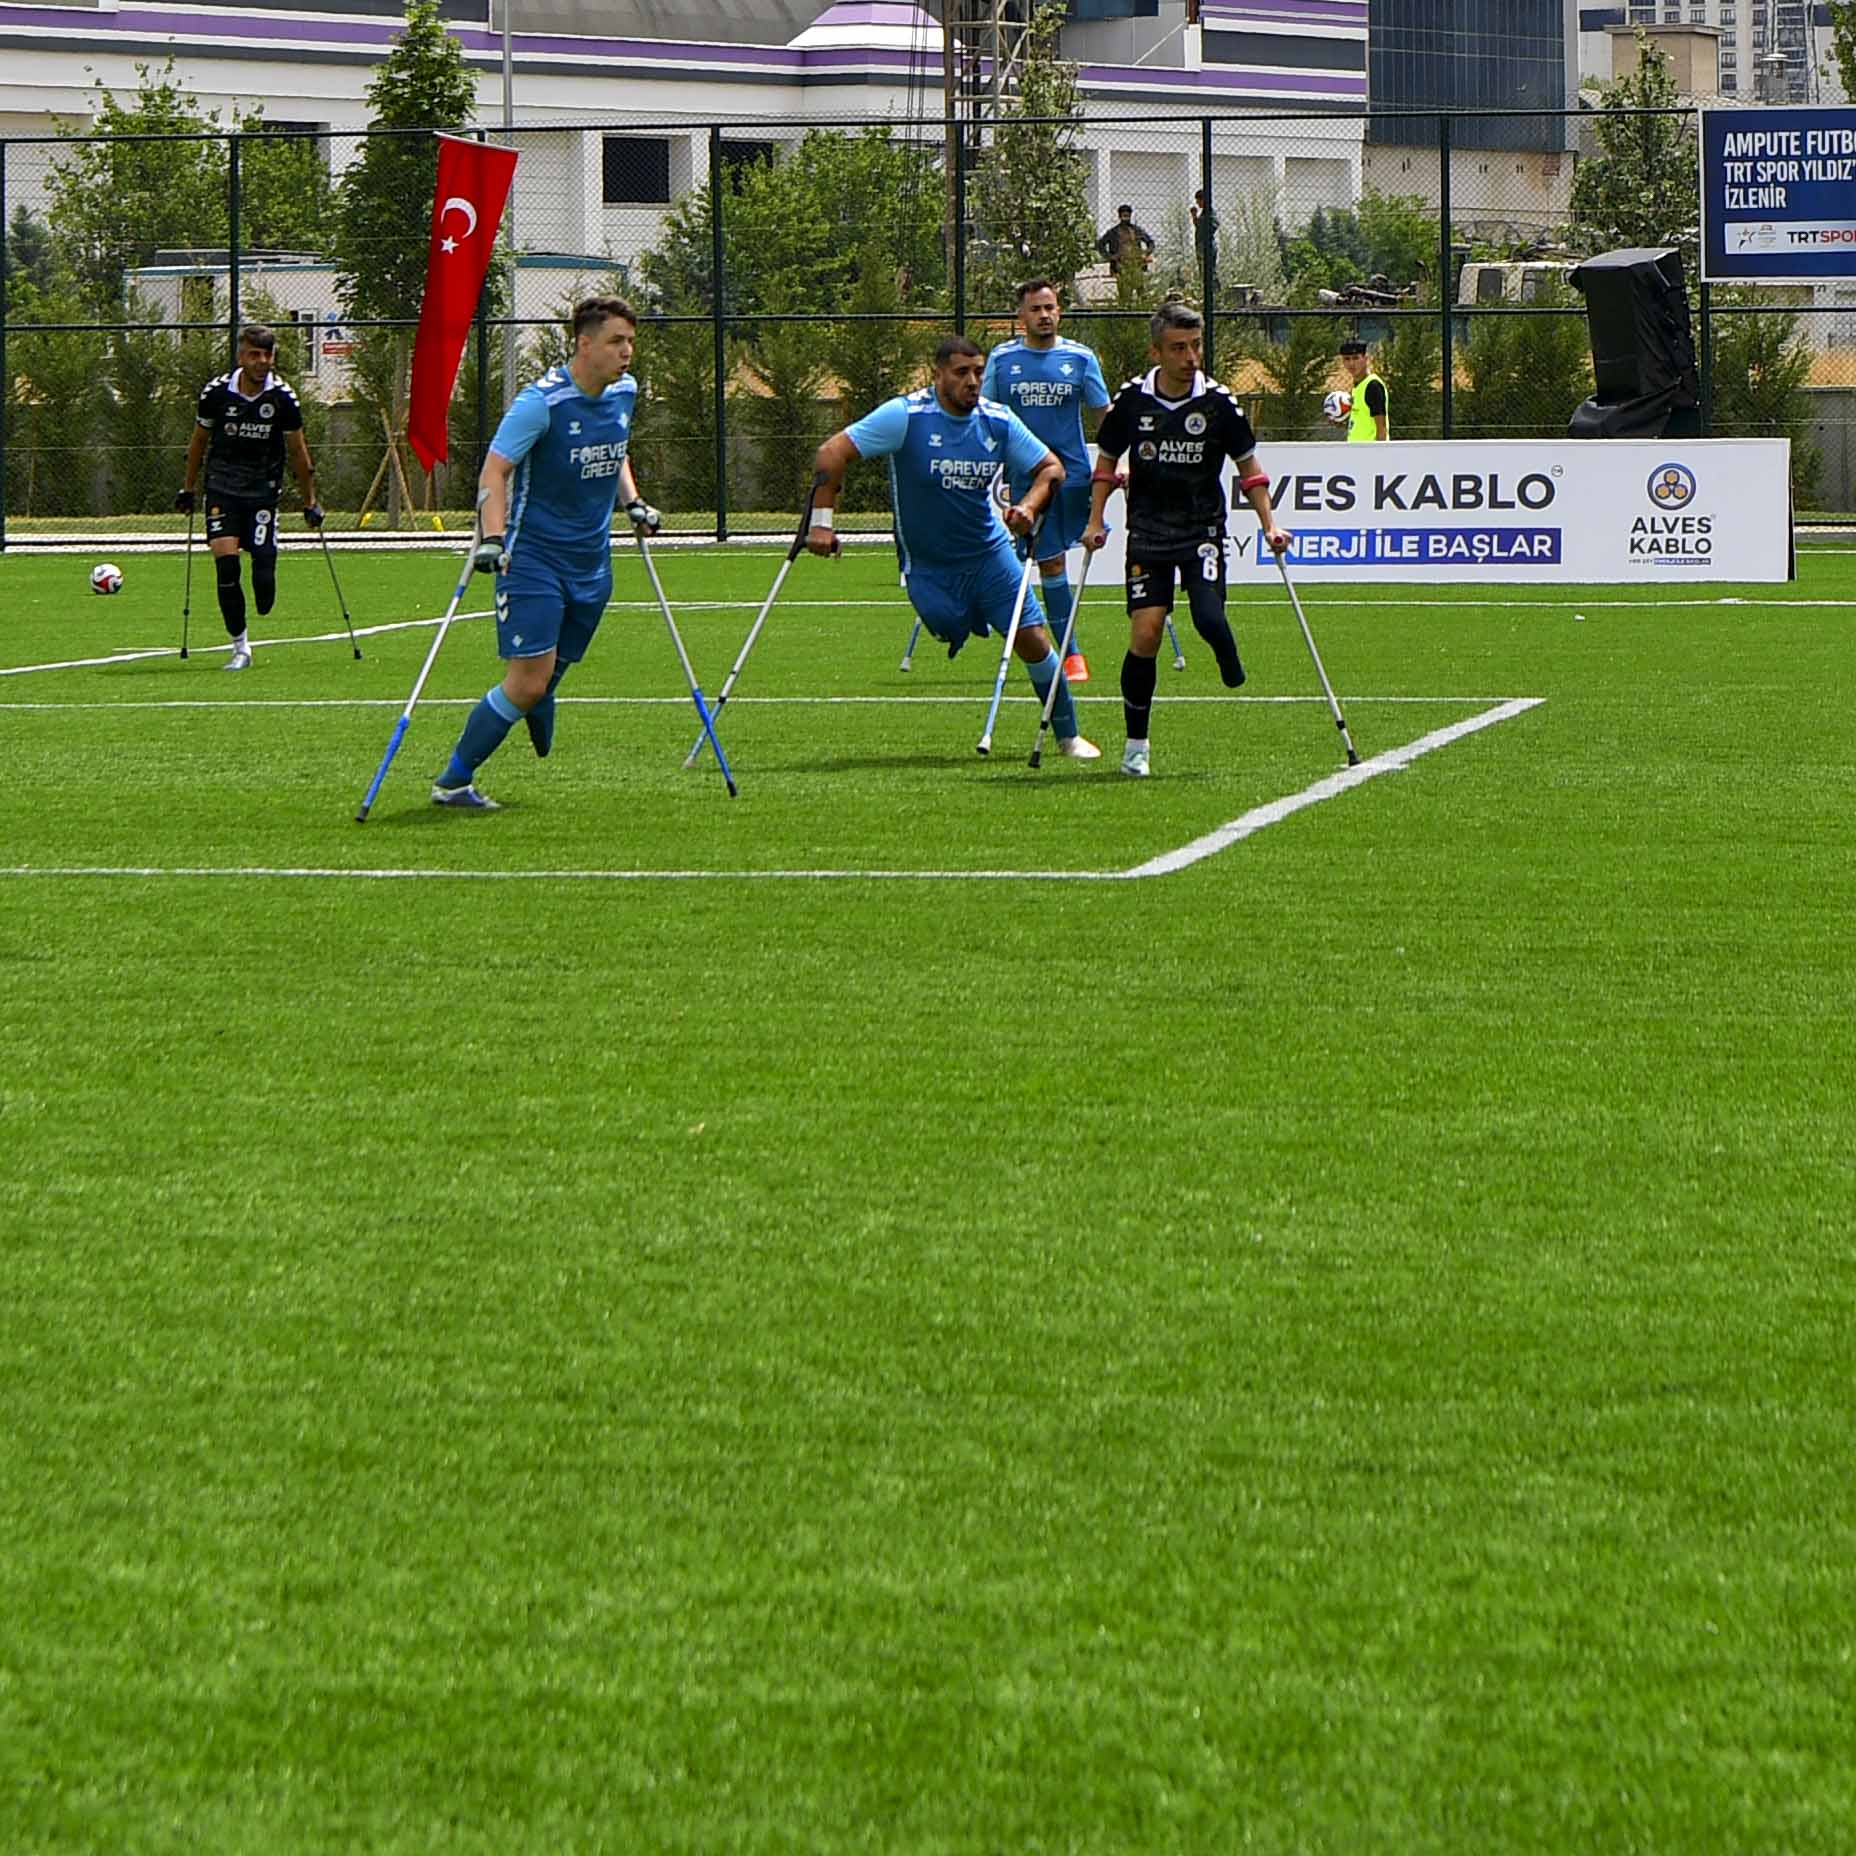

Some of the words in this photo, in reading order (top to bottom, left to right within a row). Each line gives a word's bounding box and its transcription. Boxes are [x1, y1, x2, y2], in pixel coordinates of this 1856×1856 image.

[1723, 131, 1801, 158] AMPUTE
[1724, 162, 1755, 183] TRT
[1757, 161, 1798, 182] SPOR
[1724, 183, 1786, 210] İZLENİR
[1010, 381, 1073, 396] FOREVER
[1020, 394, 1064, 407] GREEN
[240, 423, 272, 433] ALVES
[1159, 440, 1204, 453] ALVES
[1158, 452, 1204, 464] KABLO
[1231, 474, 1356, 512] LVES
[1373, 473, 1556, 511] KABLO
[253, 524, 267, 546] 9
[1630, 516, 1712, 534] ALVES
[1375, 529, 1420, 558] İLE
[1428, 534, 1553, 564] BAŞLAR
[1629, 537, 1712, 554] KABLO
[1202, 556, 1219, 582] 6
